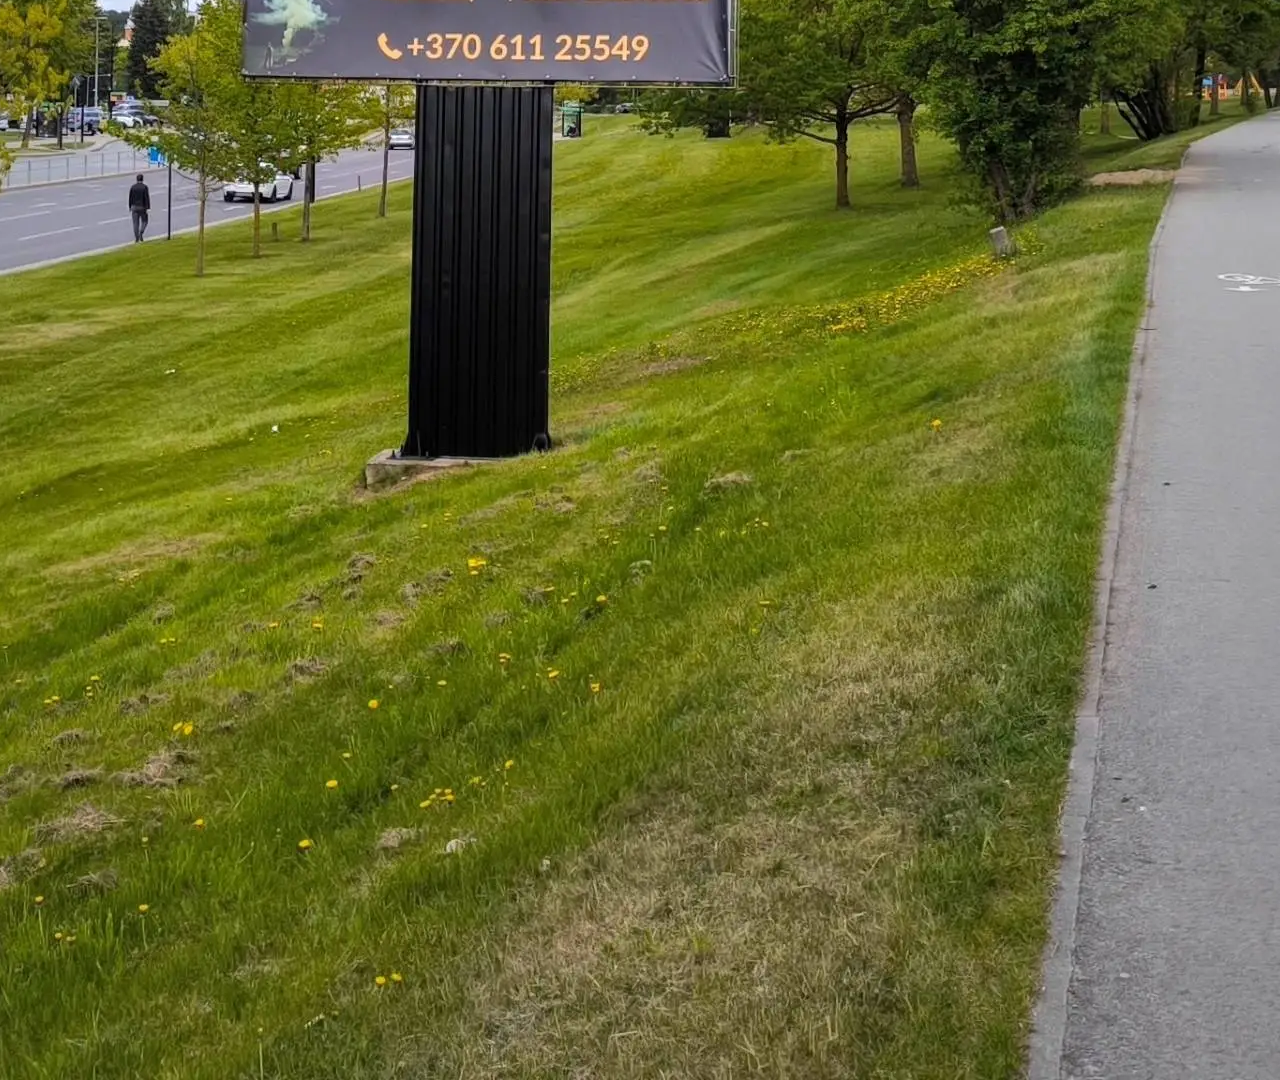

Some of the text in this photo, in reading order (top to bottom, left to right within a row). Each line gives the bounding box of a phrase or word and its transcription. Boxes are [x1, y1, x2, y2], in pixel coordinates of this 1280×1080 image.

[407, 34, 650, 62] +370 611 25549
